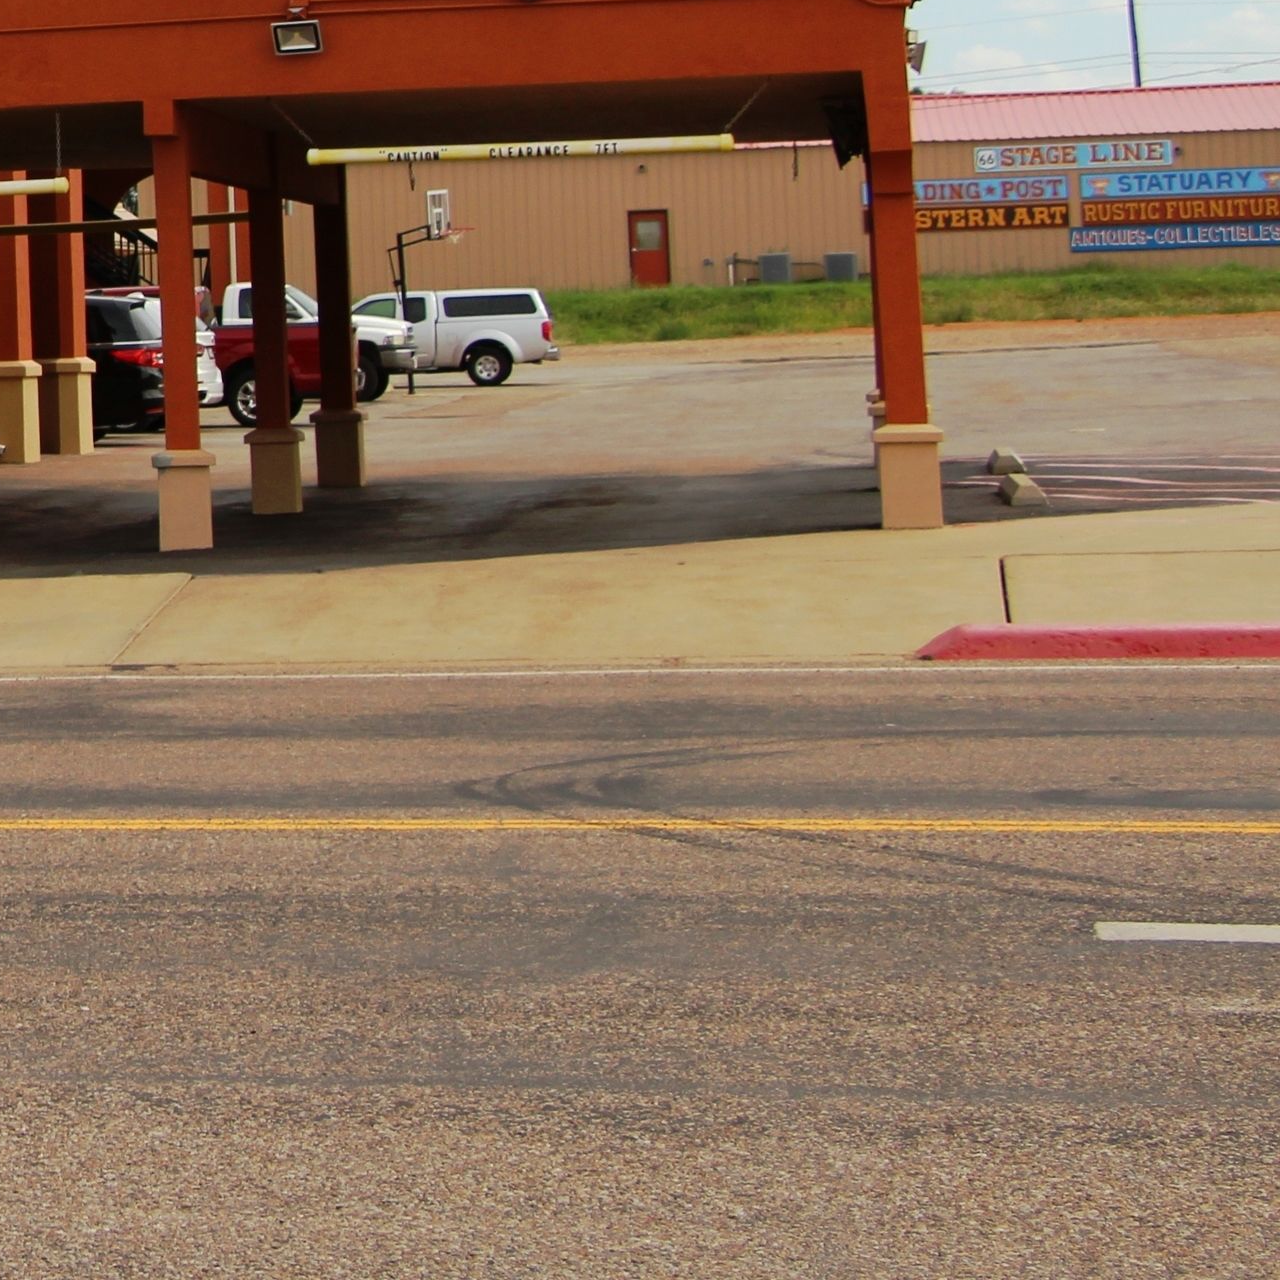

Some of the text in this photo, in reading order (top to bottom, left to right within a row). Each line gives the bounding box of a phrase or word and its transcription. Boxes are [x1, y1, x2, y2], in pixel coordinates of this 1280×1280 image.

[489, 144, 570, 159] CLEARANCE
[978, 141, 1164, 167] 66 STAGE LINE
[999, 178, 1063, 199] POST
[1117, 170, 1252, 193] STATUARY
[1012, 206, 1067, 226] ART
[1083, 201, 1159, 222] RUSTIC
